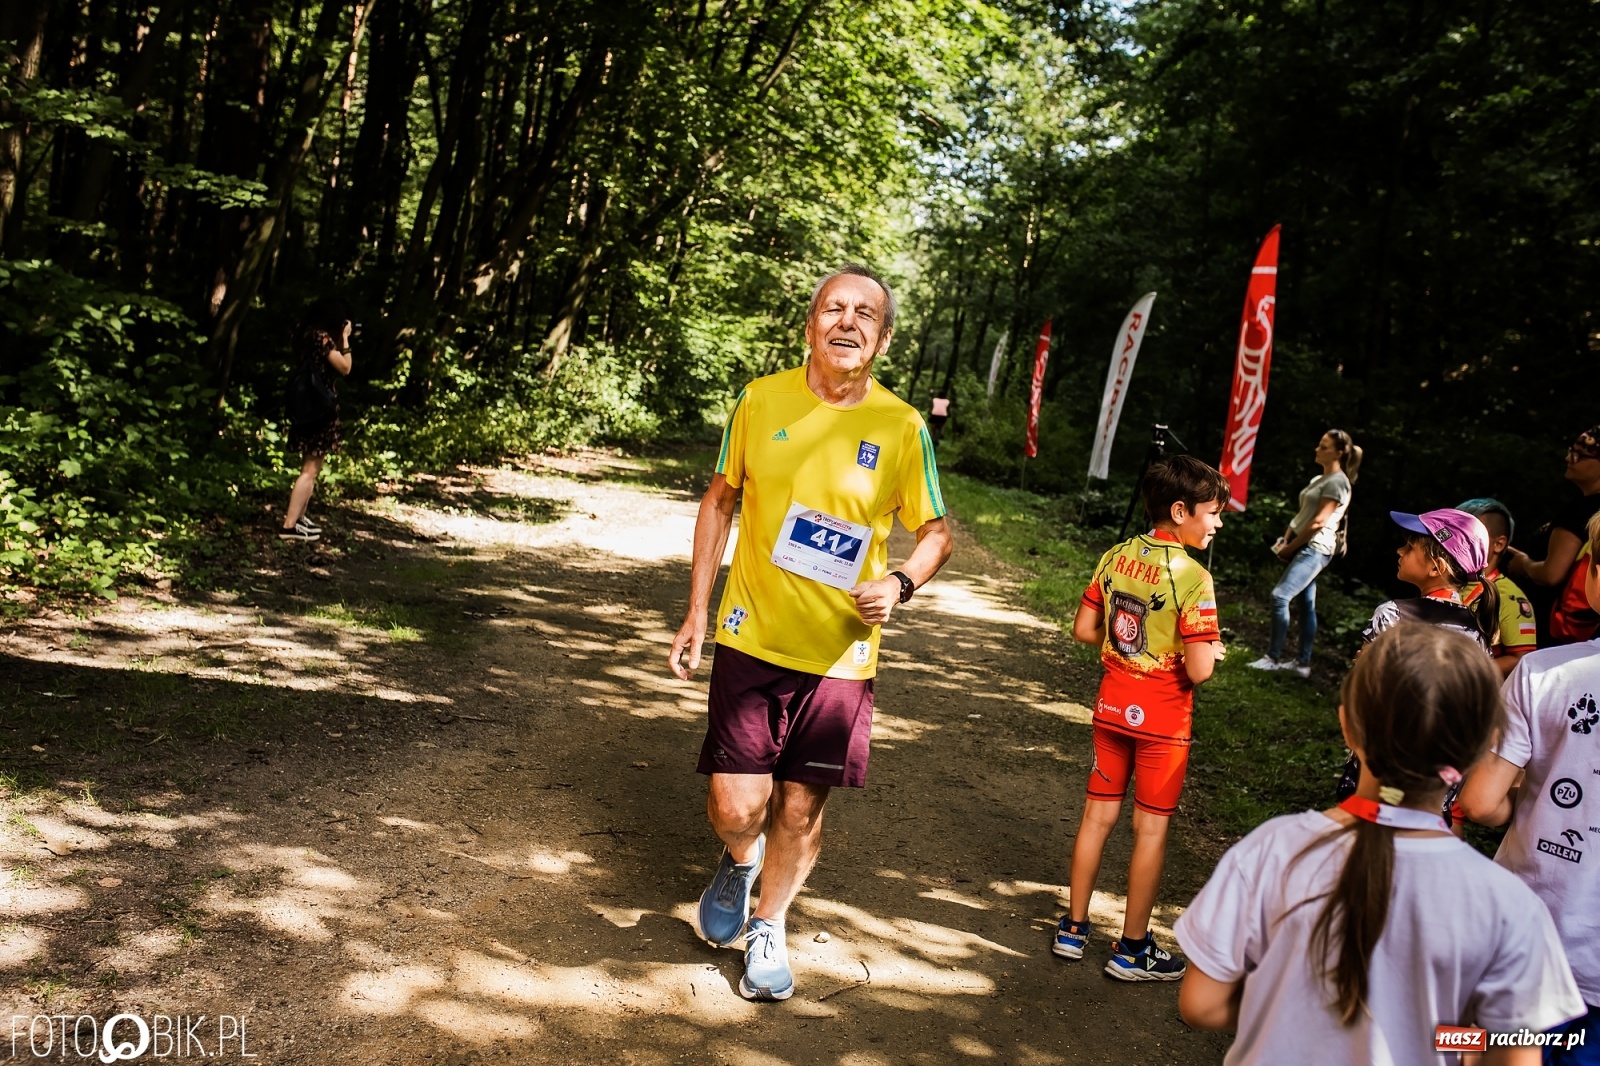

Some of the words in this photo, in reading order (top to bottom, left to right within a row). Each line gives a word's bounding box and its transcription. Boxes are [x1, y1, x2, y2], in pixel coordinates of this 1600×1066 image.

[810, 528, 842, 552] 41
[1114, 555, 1160, 585] RAFAŁ
[1557, 786, 1576, 800] PZU
[1540, 841, 1579, 861] ORLEN
